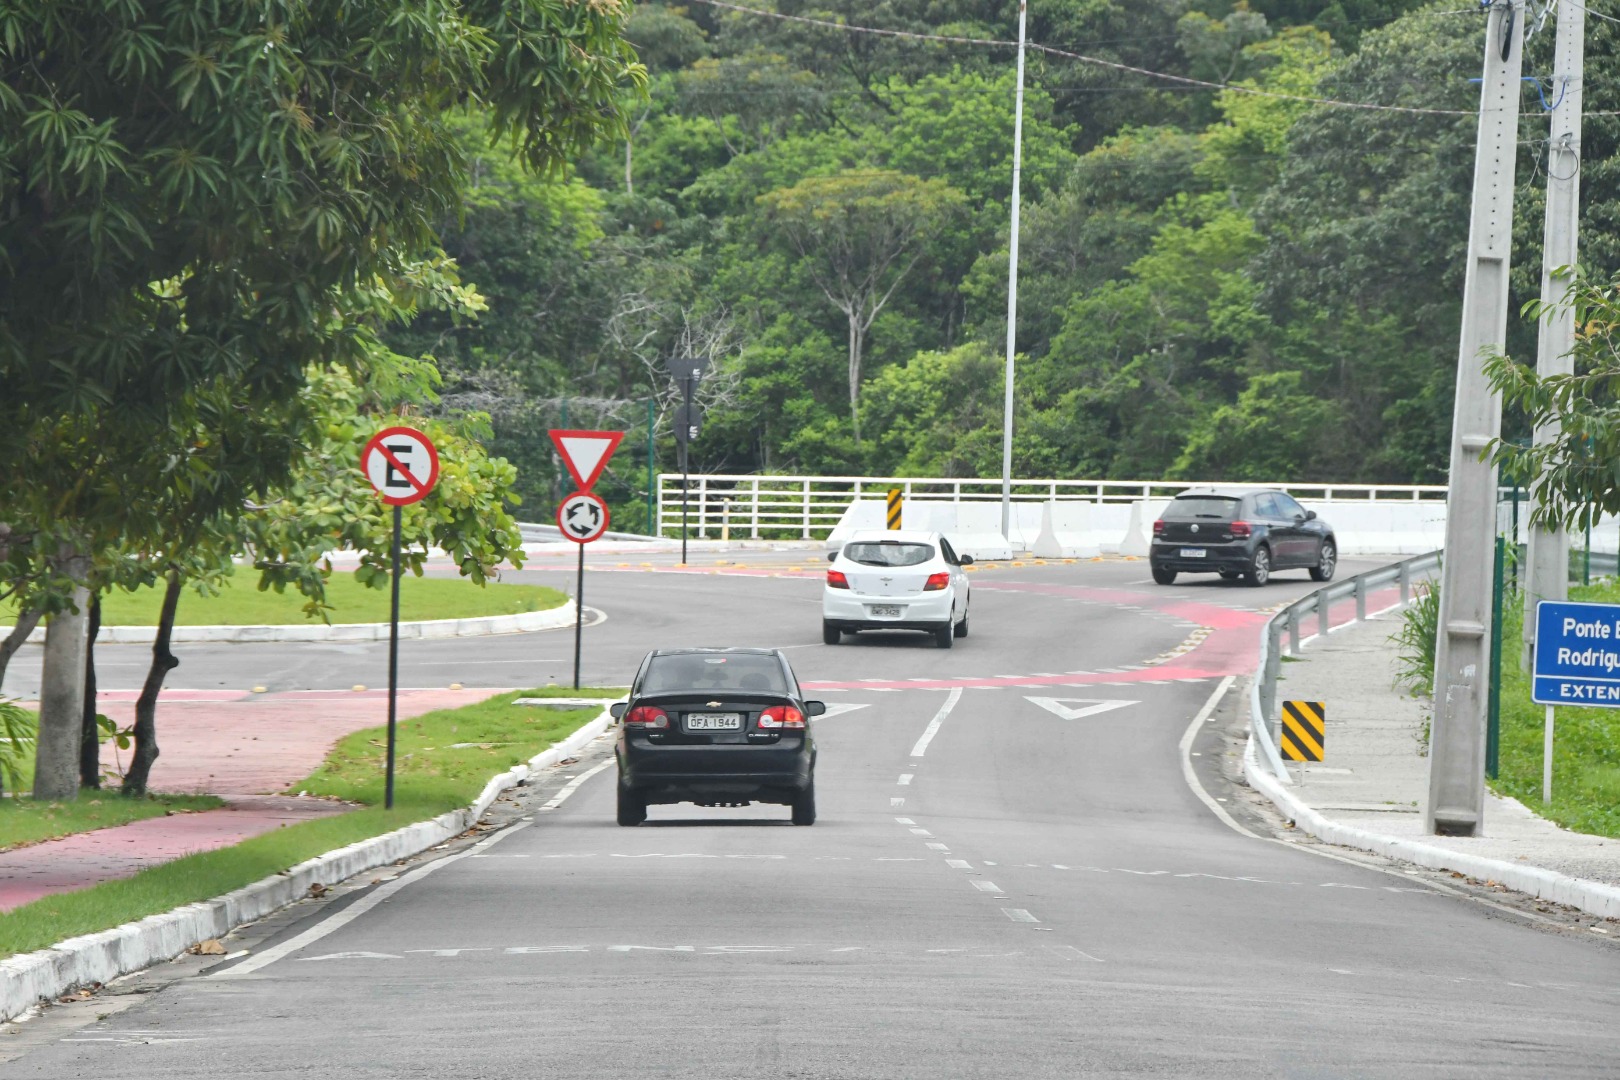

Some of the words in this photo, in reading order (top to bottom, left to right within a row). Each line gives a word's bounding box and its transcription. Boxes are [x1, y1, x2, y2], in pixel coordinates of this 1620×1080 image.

[386, 445, 412, 488] E
[1563, 617, 1611, 639] Ponte
[1560, 684, 1620, 700] EXTEN
